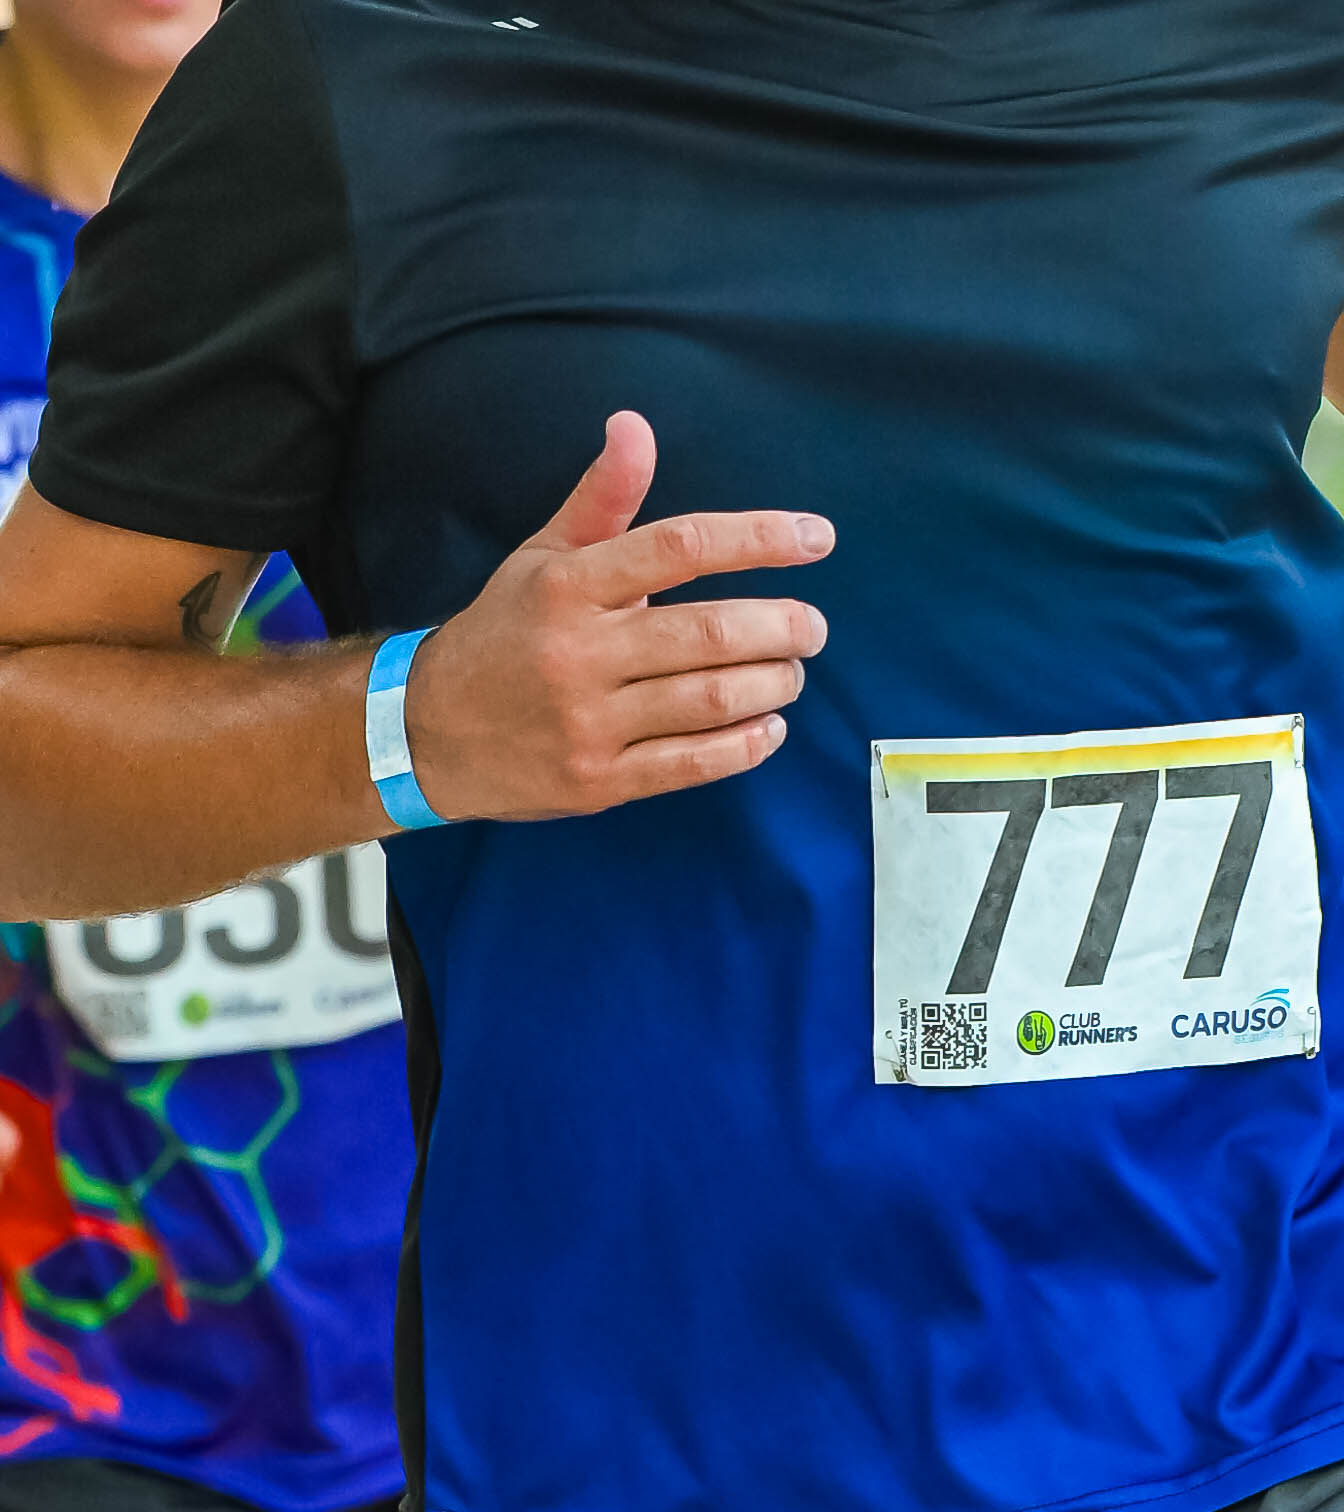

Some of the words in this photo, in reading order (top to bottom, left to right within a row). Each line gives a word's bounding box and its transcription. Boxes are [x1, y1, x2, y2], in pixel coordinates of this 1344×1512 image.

[925, 760, 1273, 995] 777
[1059, 1012, 1101, 1029] CLUB
[1171, 1005, 1287, 1038] CARUSO
[1058, 1026, 1138, 1046] RUNNER'S
